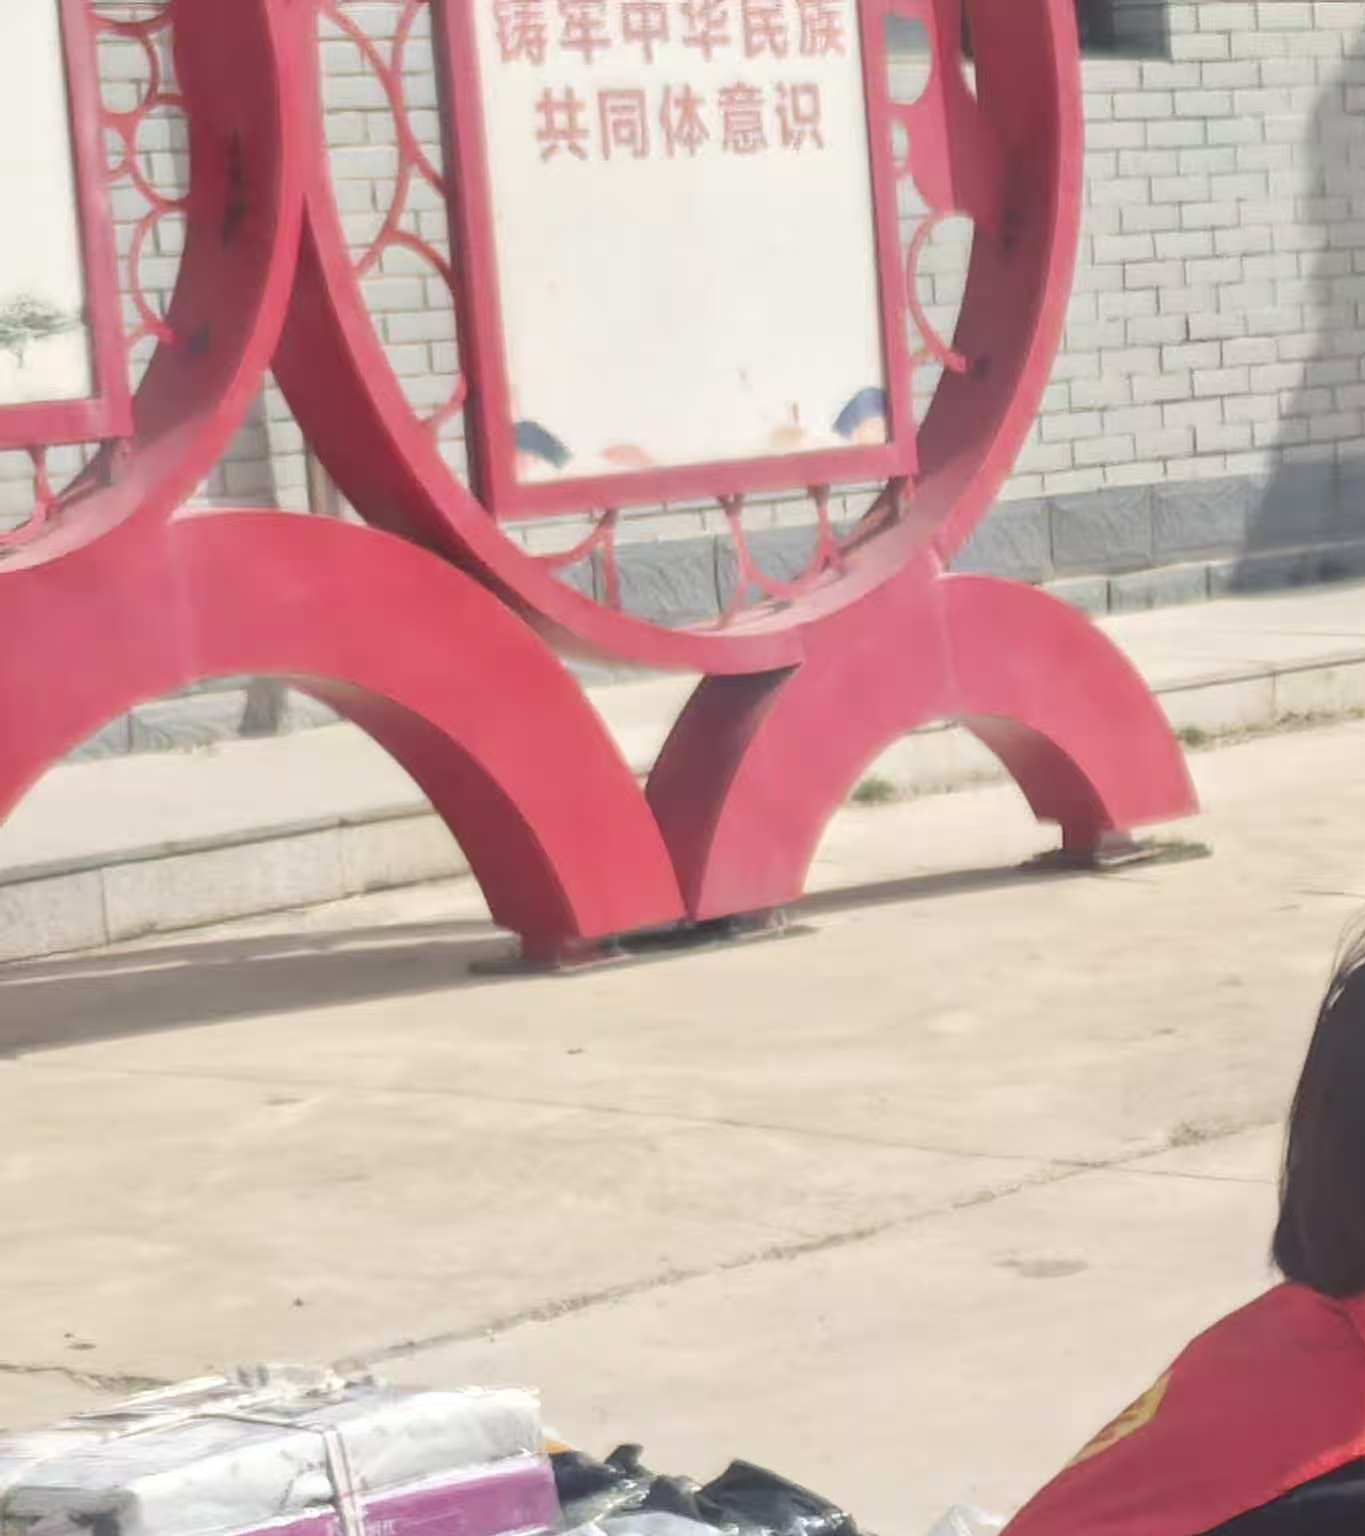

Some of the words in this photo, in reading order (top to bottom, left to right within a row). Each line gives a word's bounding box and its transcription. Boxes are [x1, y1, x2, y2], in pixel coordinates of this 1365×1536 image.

[535, 82, 826, 162] 共同体意识
